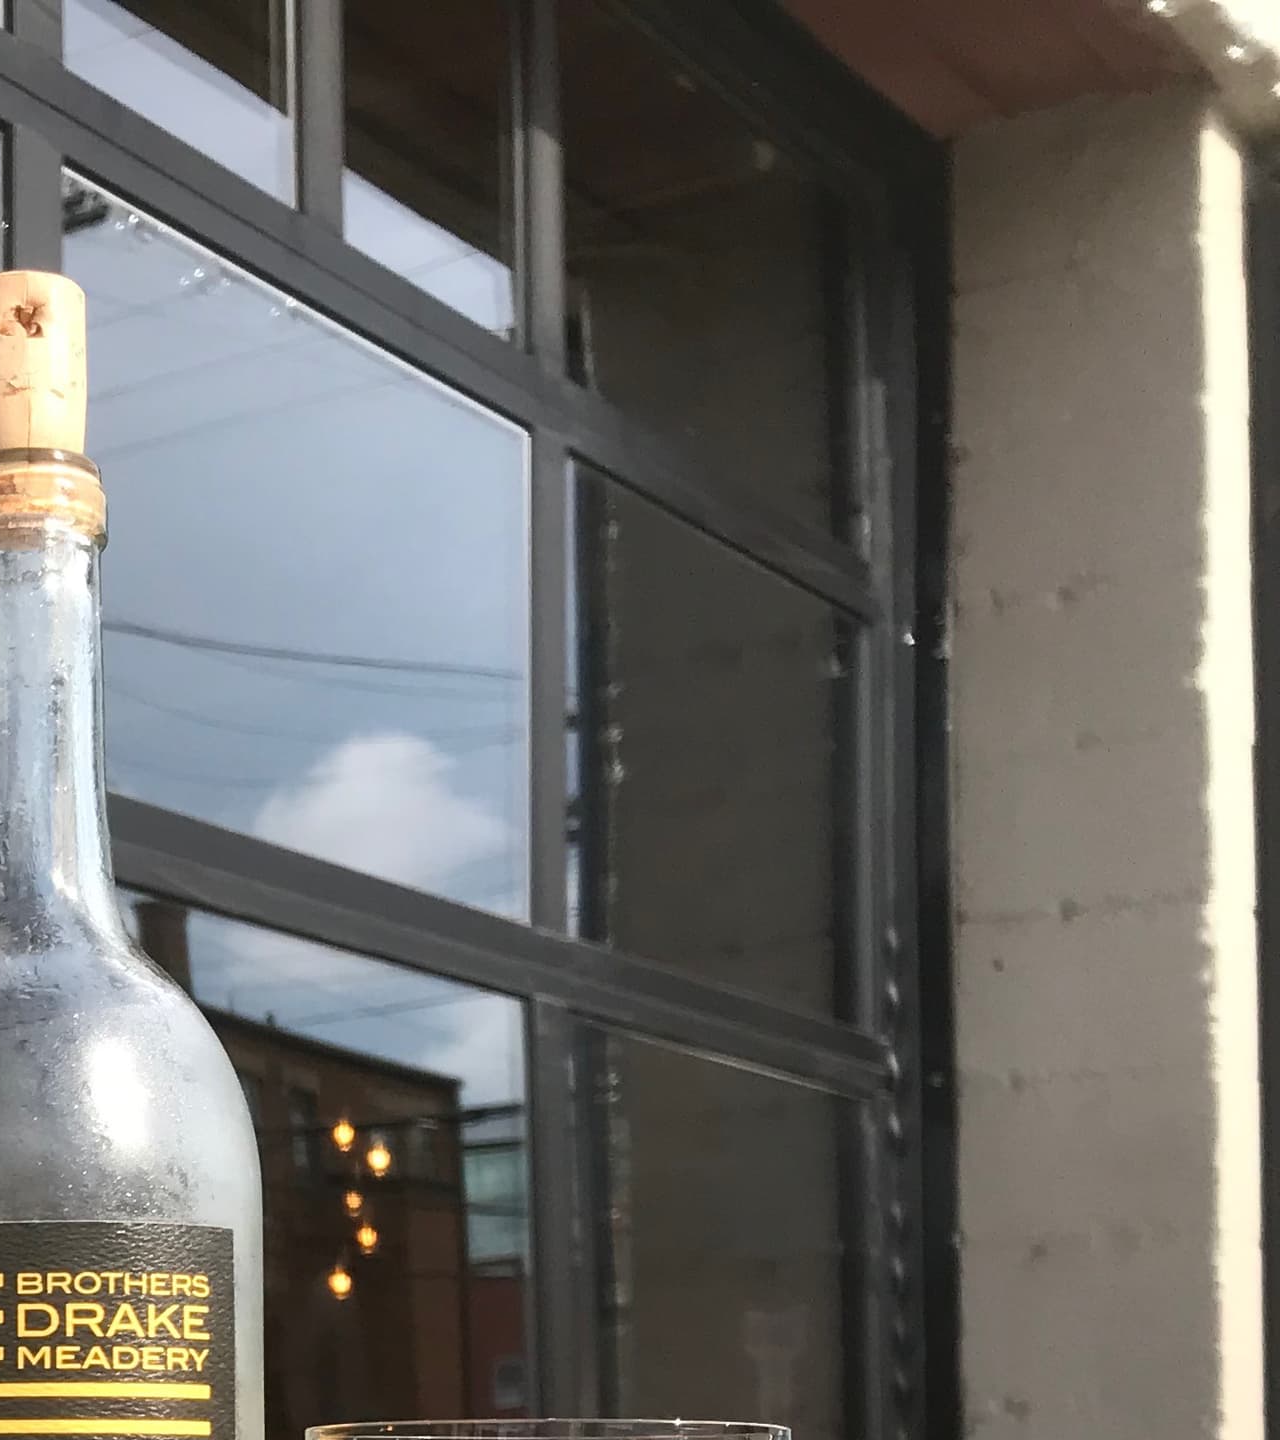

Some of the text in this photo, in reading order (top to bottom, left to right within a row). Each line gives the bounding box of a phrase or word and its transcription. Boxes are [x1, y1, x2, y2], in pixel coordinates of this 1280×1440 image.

[16, 1271, 211, 1298] BROTHERS
[16, 1303, 211, 1340] DRAKE
[17, 1346, 210, 1372] MEADERY
